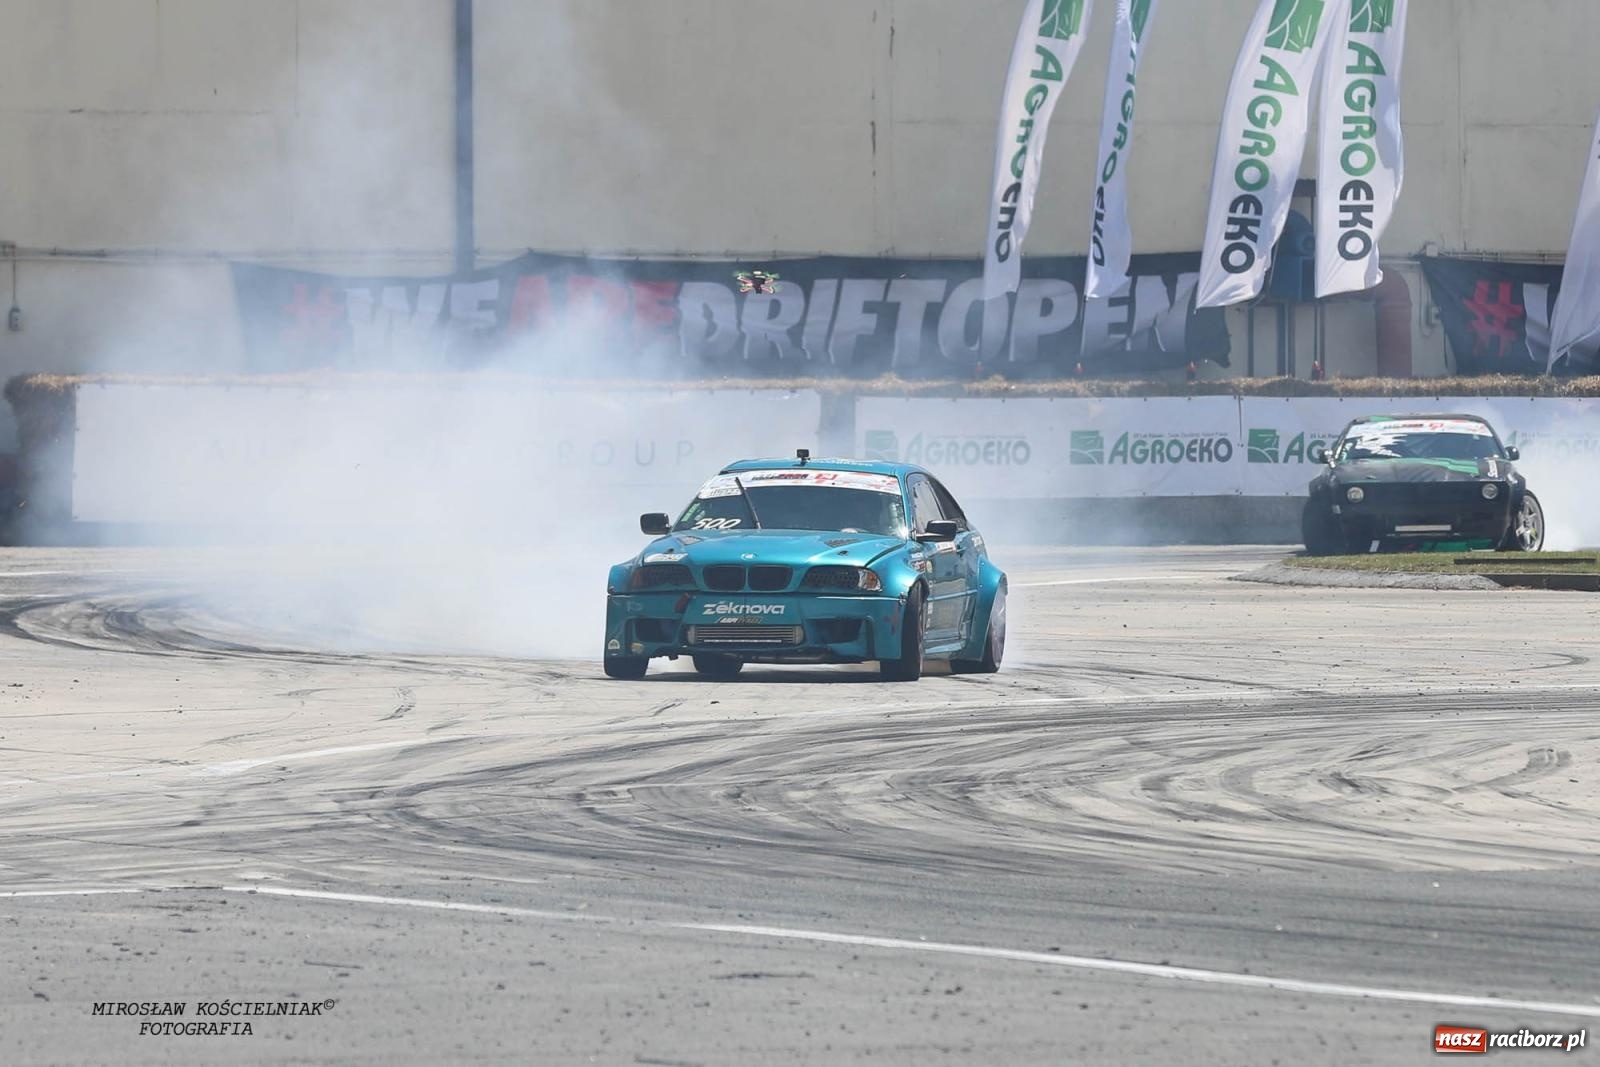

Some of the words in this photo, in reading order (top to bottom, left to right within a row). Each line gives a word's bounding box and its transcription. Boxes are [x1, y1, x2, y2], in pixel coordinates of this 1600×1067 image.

[1220, 54, 1299, 274] AGROEKO
[1340, 40, 1386, 261] AGROEKO
[907, 431, 1031, 466] AGROEKO
[1107, 430, 1233, 465] AGROEKO
[692, 518, 742, 530] 500
